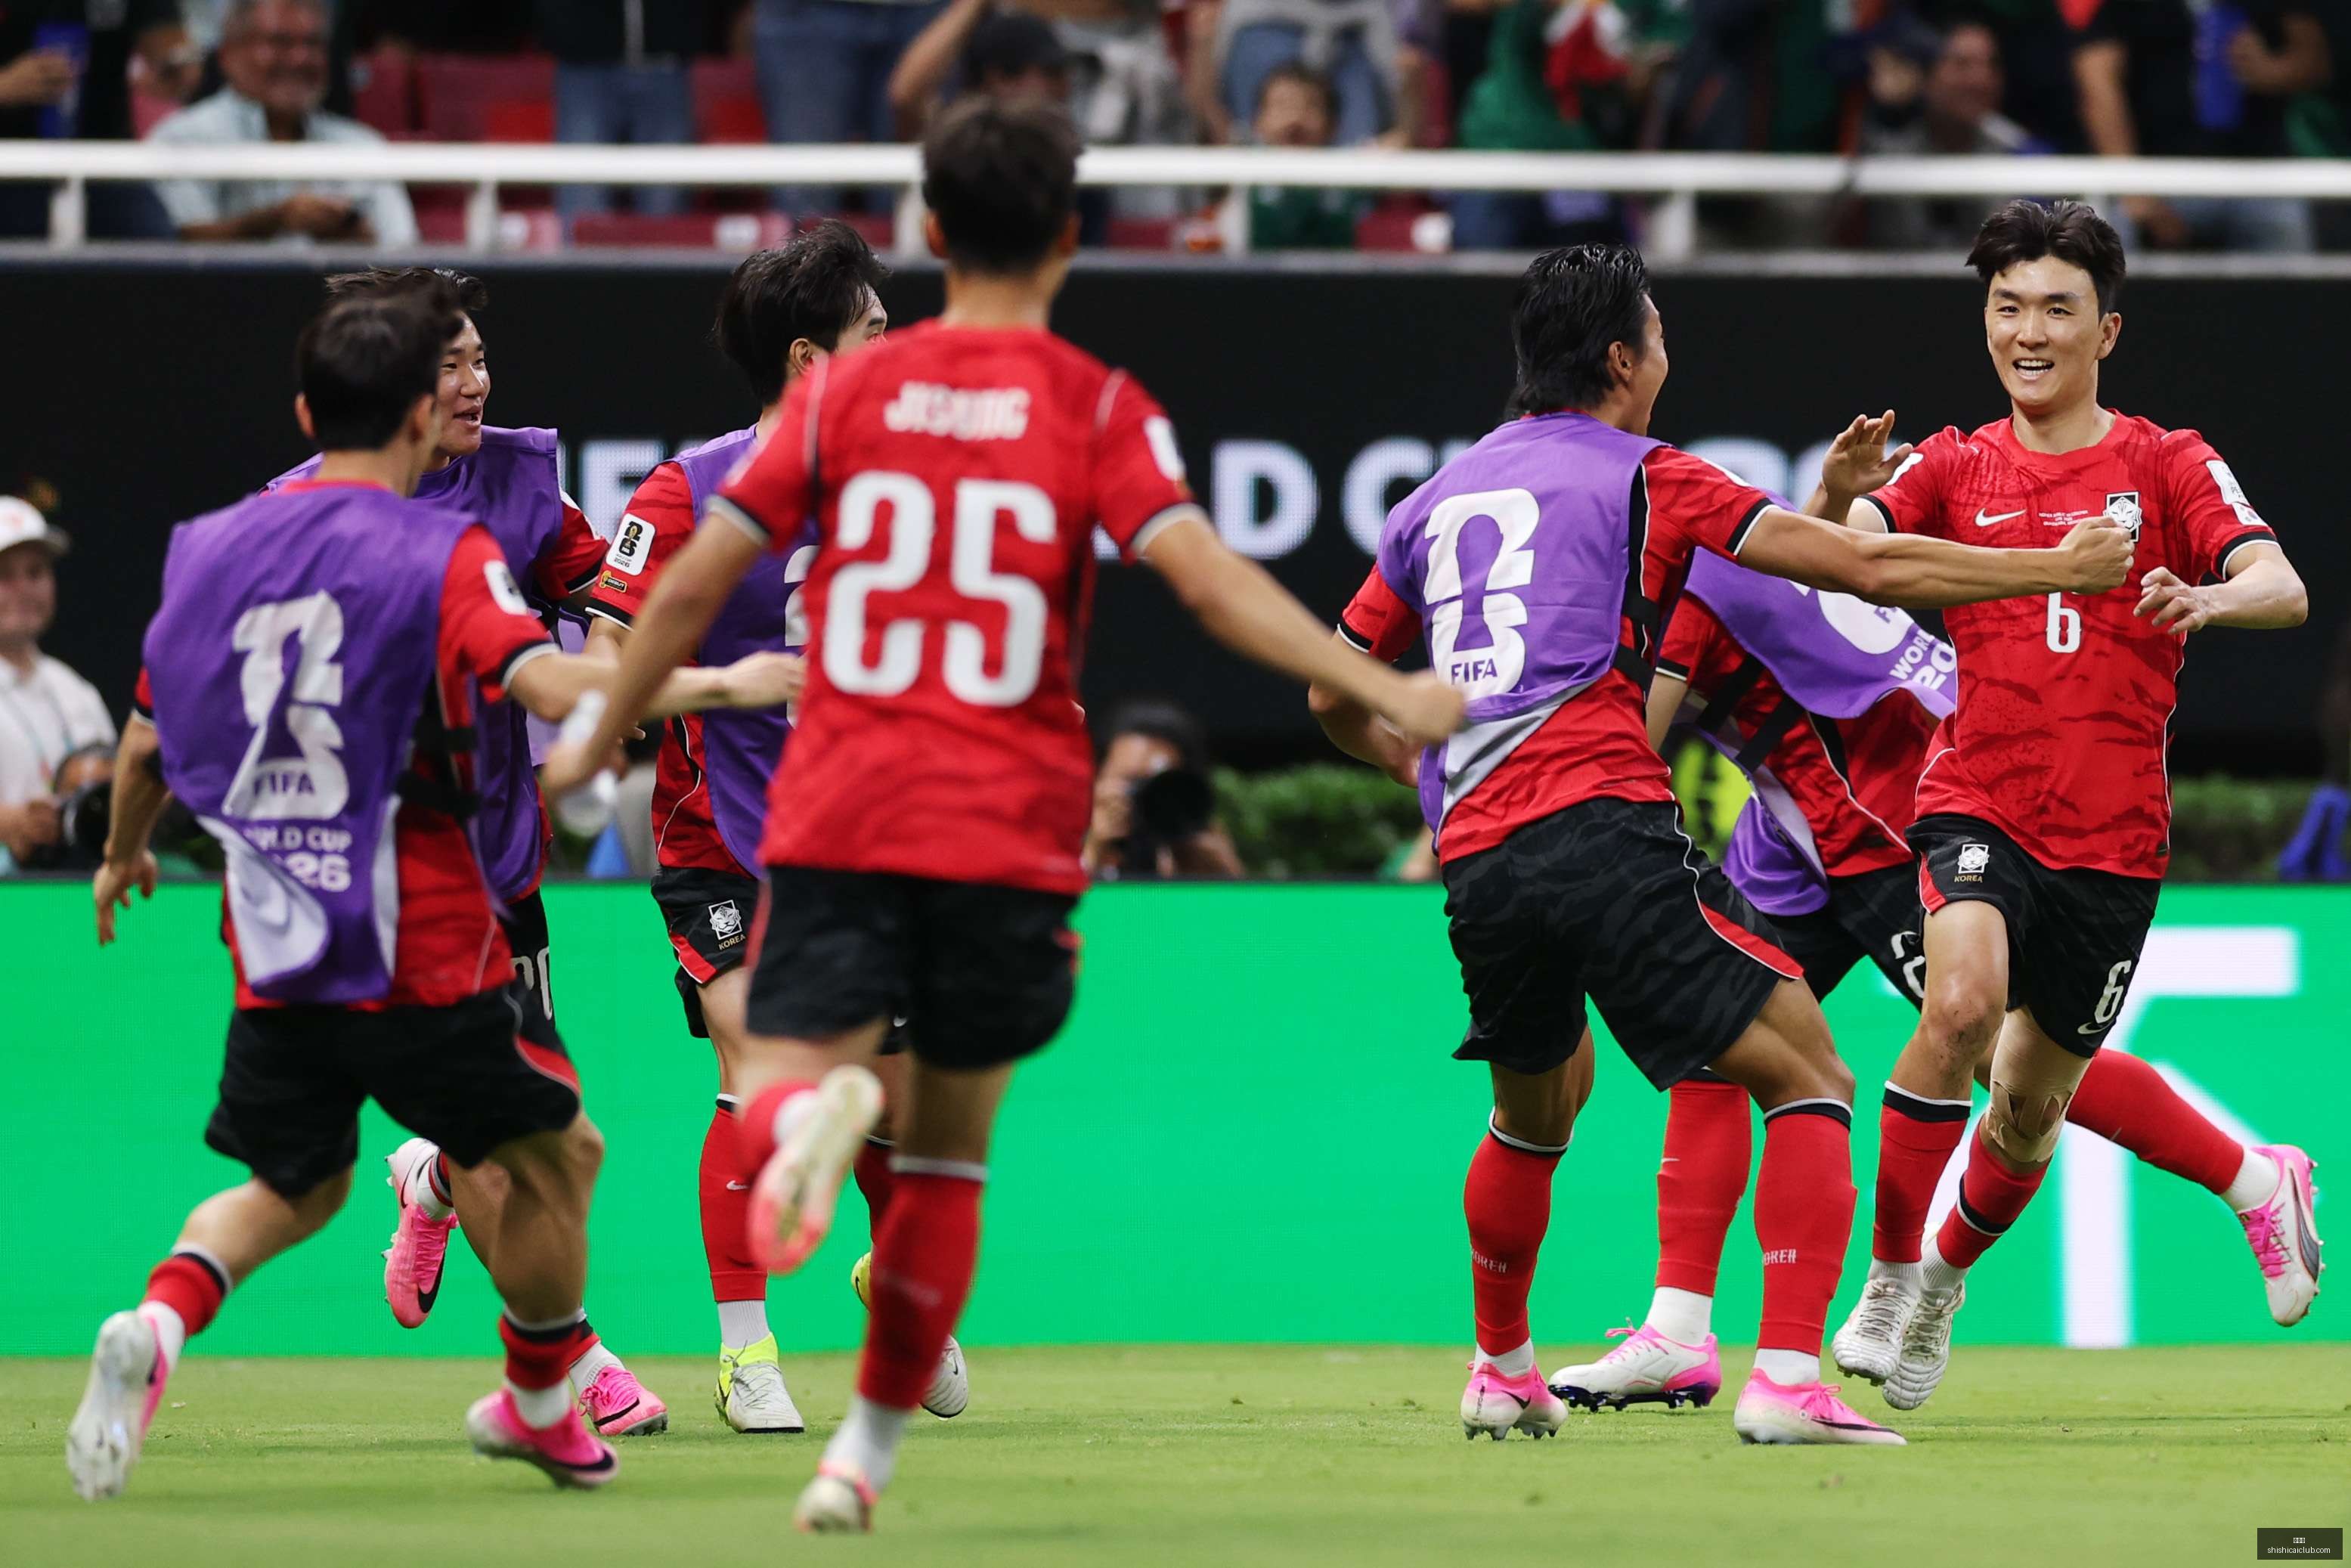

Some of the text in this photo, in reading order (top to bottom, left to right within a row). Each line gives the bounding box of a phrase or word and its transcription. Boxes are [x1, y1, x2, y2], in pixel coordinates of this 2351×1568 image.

[822, 469, 1057, 708] 25
[2045, 590, 2082, 654] 6
[1451, 657, 1498, 685] FIFA
[1889, 628, 1937, 680] WORL
[1953, 875, 1984, 883] KOREA
[718, 934, 746, 950] KOREA
[2094, 959, 2132, 1024] 6
[1764, 1248, 1797, 1266] OREA
